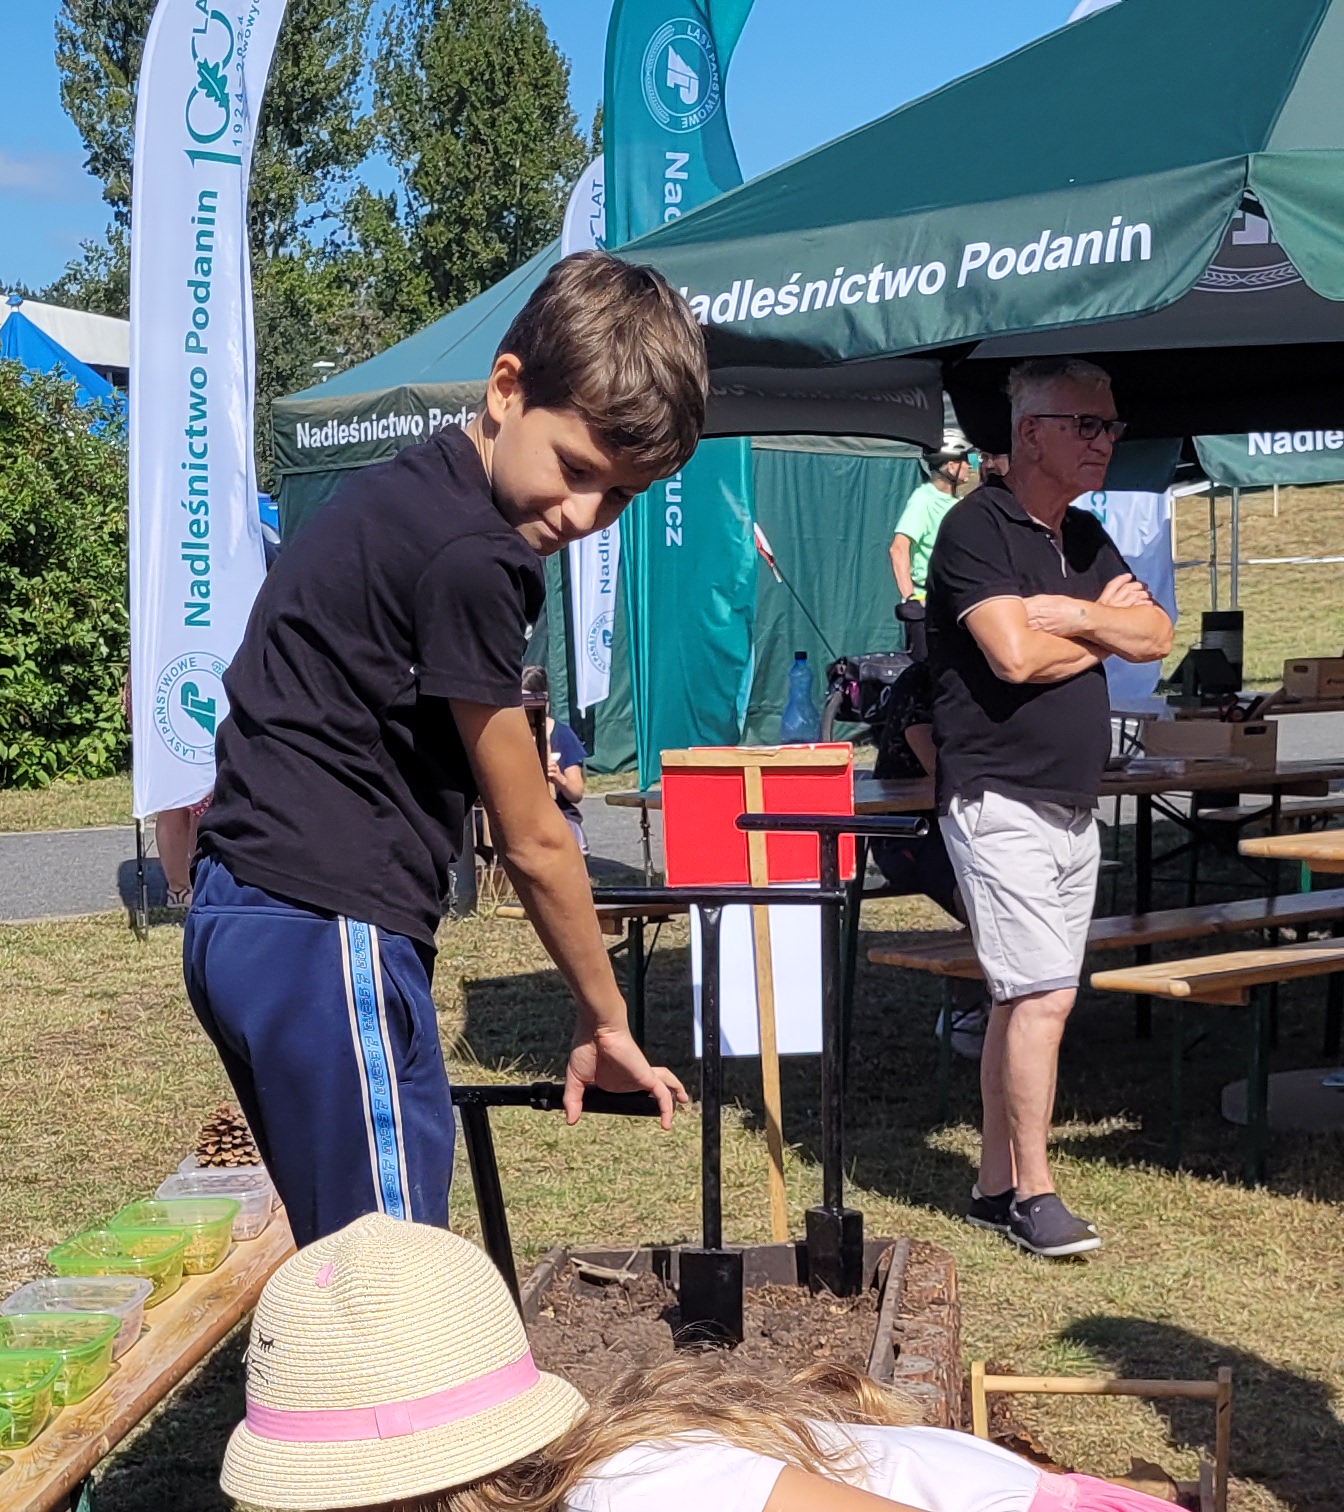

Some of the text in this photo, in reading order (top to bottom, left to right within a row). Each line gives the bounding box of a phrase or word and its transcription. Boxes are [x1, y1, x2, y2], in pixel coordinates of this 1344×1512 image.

[687, 24, 712, 51] LASY
[956, 215, 1152, 288] Podanin
[181, 188, 218, 628] Nadleśnictwo Podanin
[296, 411, 424, 448] Nadleśnictwo
[167, 736, 196, 760] LASY
